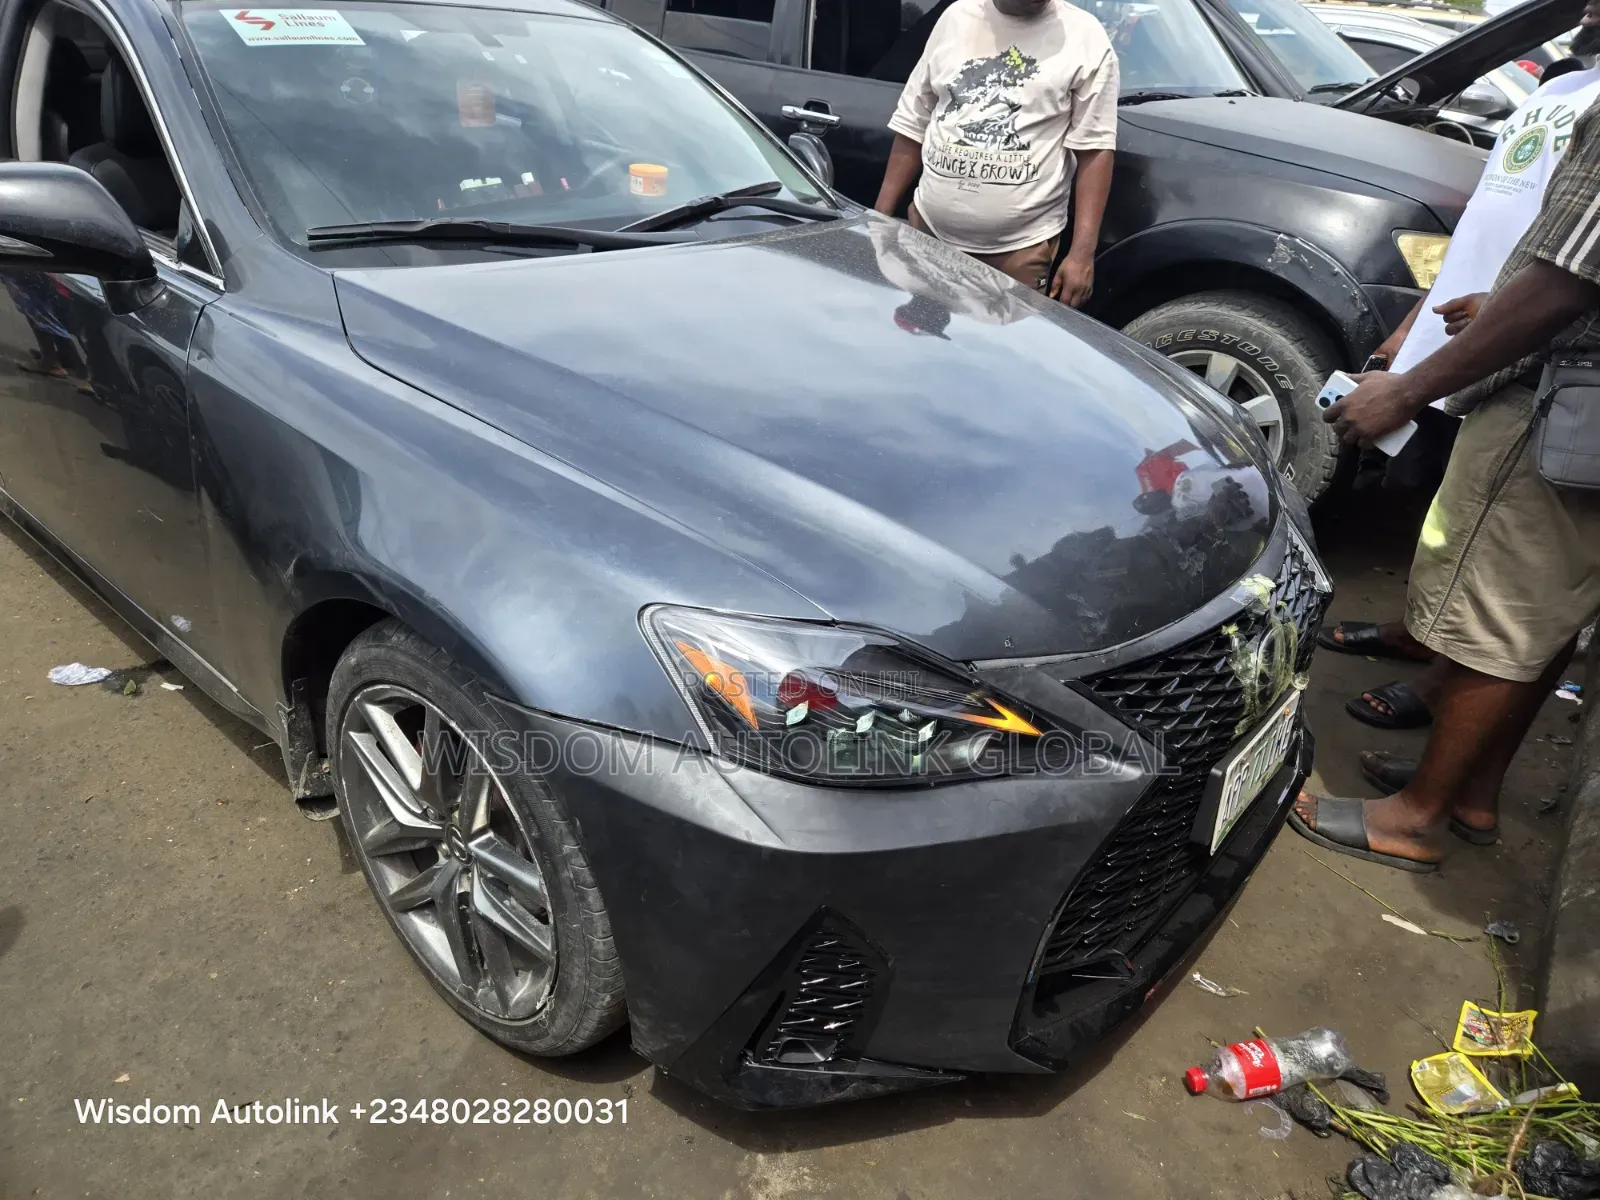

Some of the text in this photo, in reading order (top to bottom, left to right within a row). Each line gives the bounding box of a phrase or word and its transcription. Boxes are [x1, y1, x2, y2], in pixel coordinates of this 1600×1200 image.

[279, 13, 338, 22] Sallaum
[286, 20, 326, 28] Lines
[954, 147, 993, 161] REQUIRES
[1004, 155, 1031, 163] LITTLE
[980, 162, 1040, 181] GROWTH
